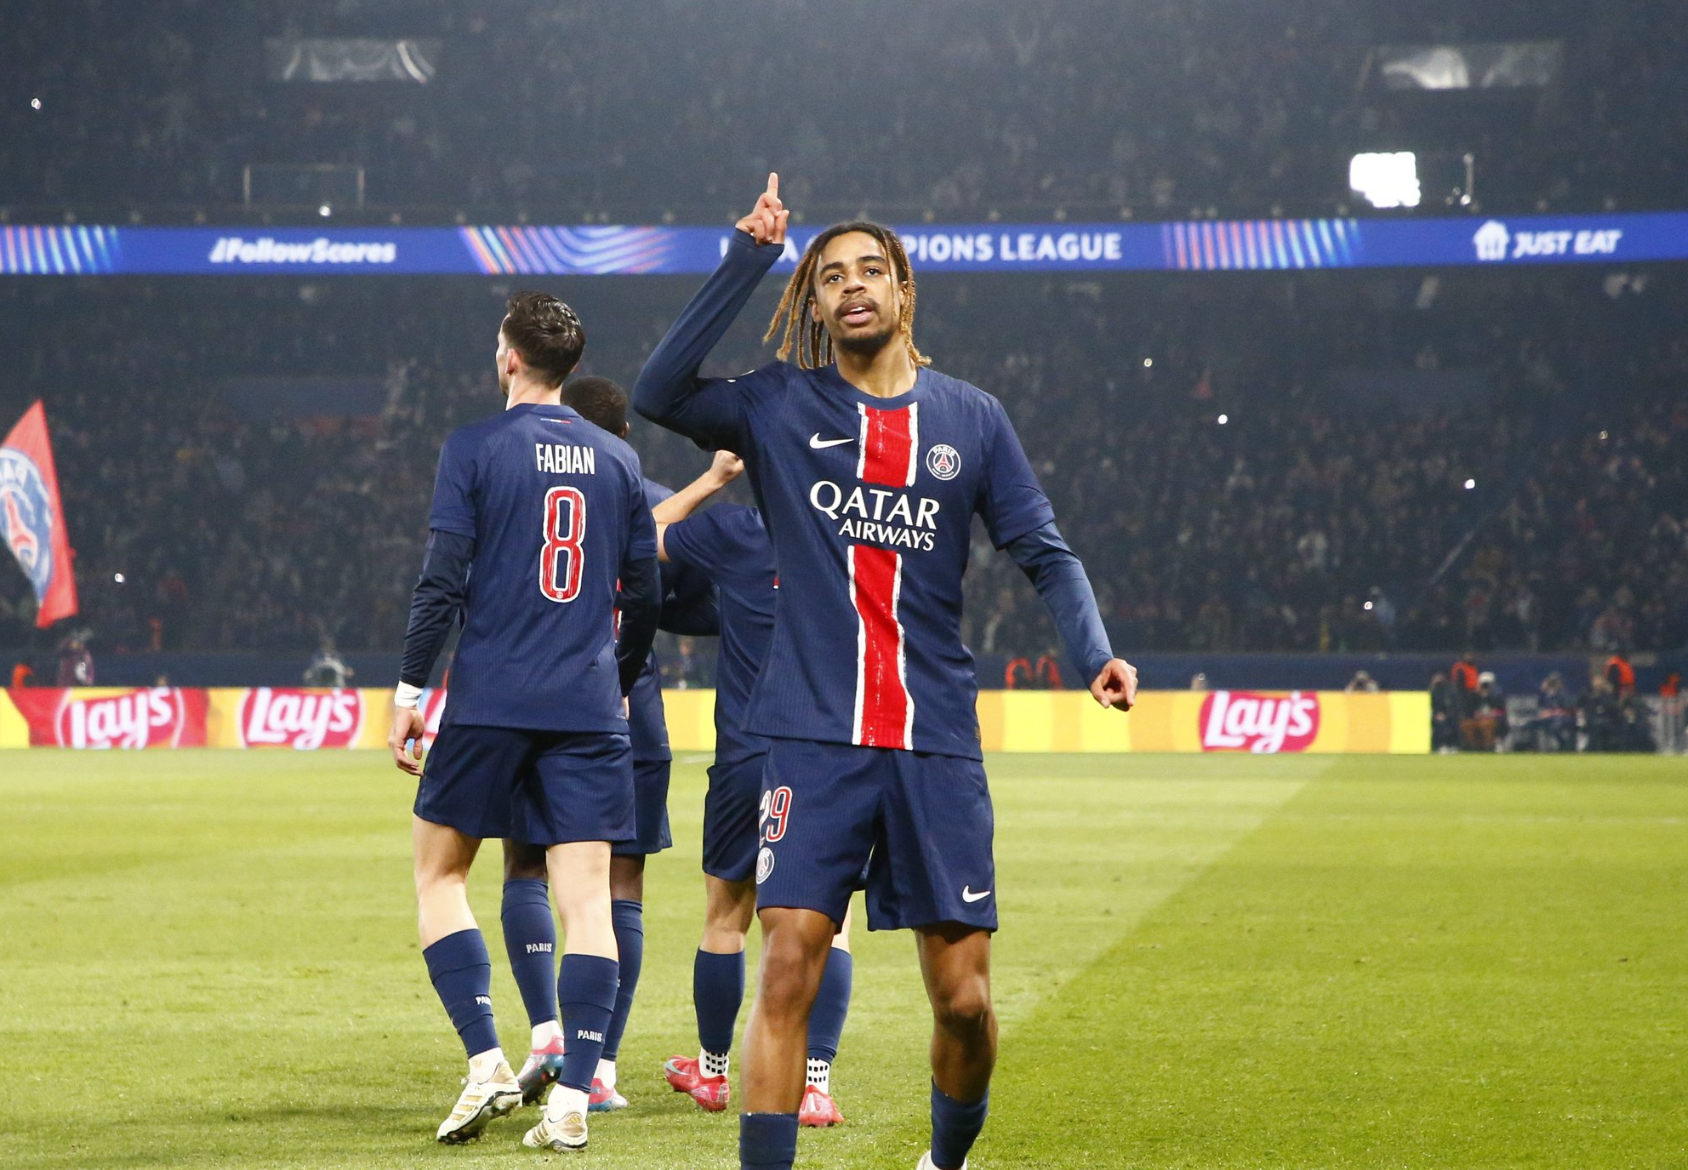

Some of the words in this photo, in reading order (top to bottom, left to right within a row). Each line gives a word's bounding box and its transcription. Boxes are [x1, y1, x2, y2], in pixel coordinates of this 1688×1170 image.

[1000, 232, 1122, 261] LEAGUE
[1512, 231, 1573, 258] JUST
[1574, 229, 1623, 254] EAT
[535, 443, 595, 475] FABIAN
[809, 480, 940, 530] QATAR
[538, 486, 586, 603] 8
[838, 518, 935, 551] AIRWAYS
[247, 687, 356, 750] Lay's
[1204, 690, 1315, 754] Lay's
[526, 942, 552, 953] PARIS
[577, 1029, 603, 1042] PARIS
